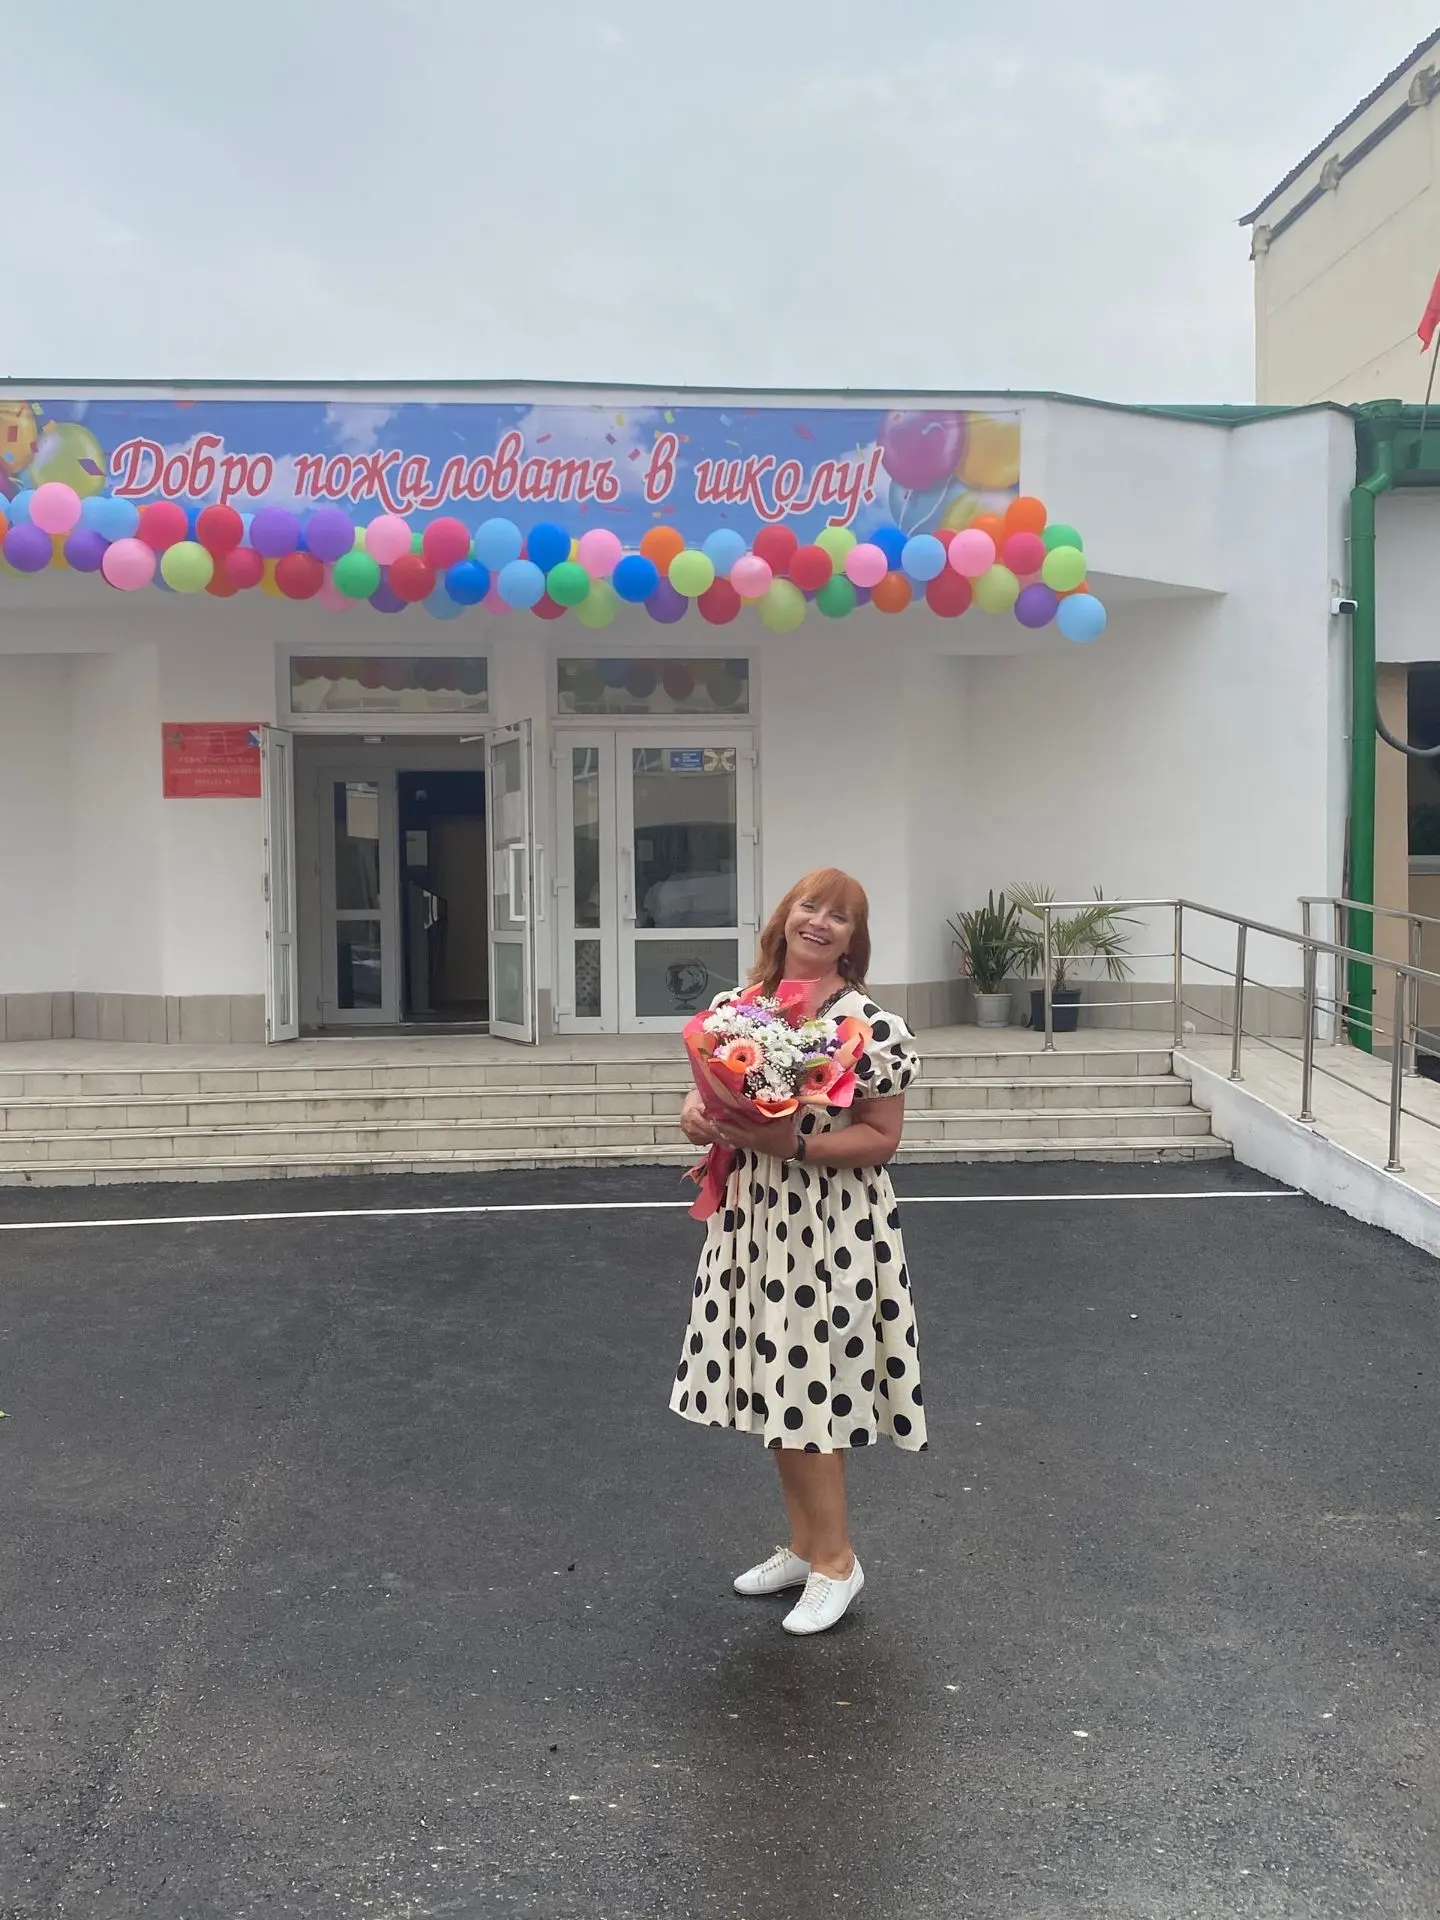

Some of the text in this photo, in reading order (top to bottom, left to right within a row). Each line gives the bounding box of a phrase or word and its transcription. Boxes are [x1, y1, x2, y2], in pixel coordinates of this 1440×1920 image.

[111, 432, 275, 504] Добро
[645, 432, 679, 503] в
[695, 446, 884, 527] школу!
